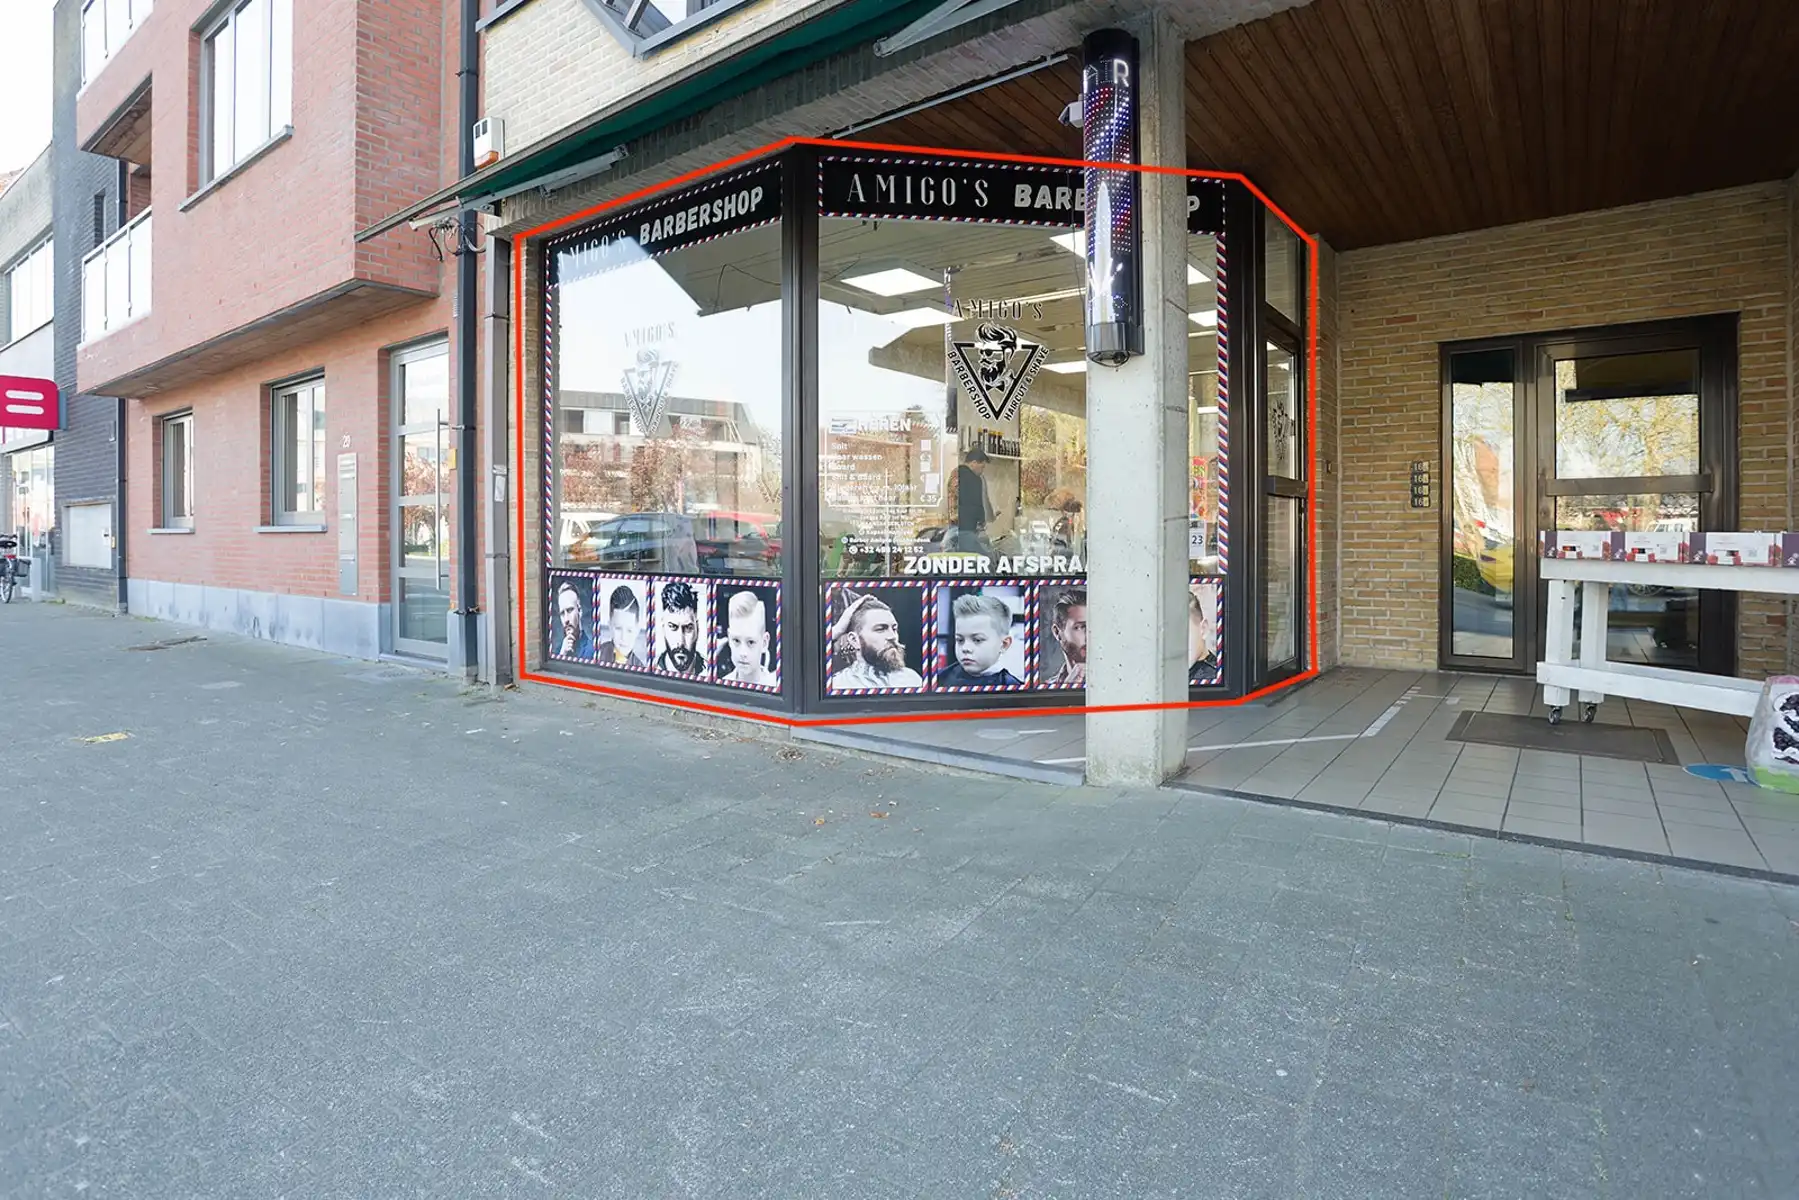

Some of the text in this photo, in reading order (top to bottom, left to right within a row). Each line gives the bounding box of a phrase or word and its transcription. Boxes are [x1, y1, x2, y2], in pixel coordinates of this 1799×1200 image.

[846, 172, 989, 208] AMIGO'S
[639, 186, 764, 246] BARBERSHOP
[953, 299, 1044, 320] AMIGO'S
[947, 350, 992, 421] BARBERSHOP
[1003, 385, 1029, 421] HAIRCUT
[1030, 346, 1050, 375] SHAVE
[1191, 535, 1203, 545] 23
[903, 555, 1088, 574] ZONDER AFSPRA
